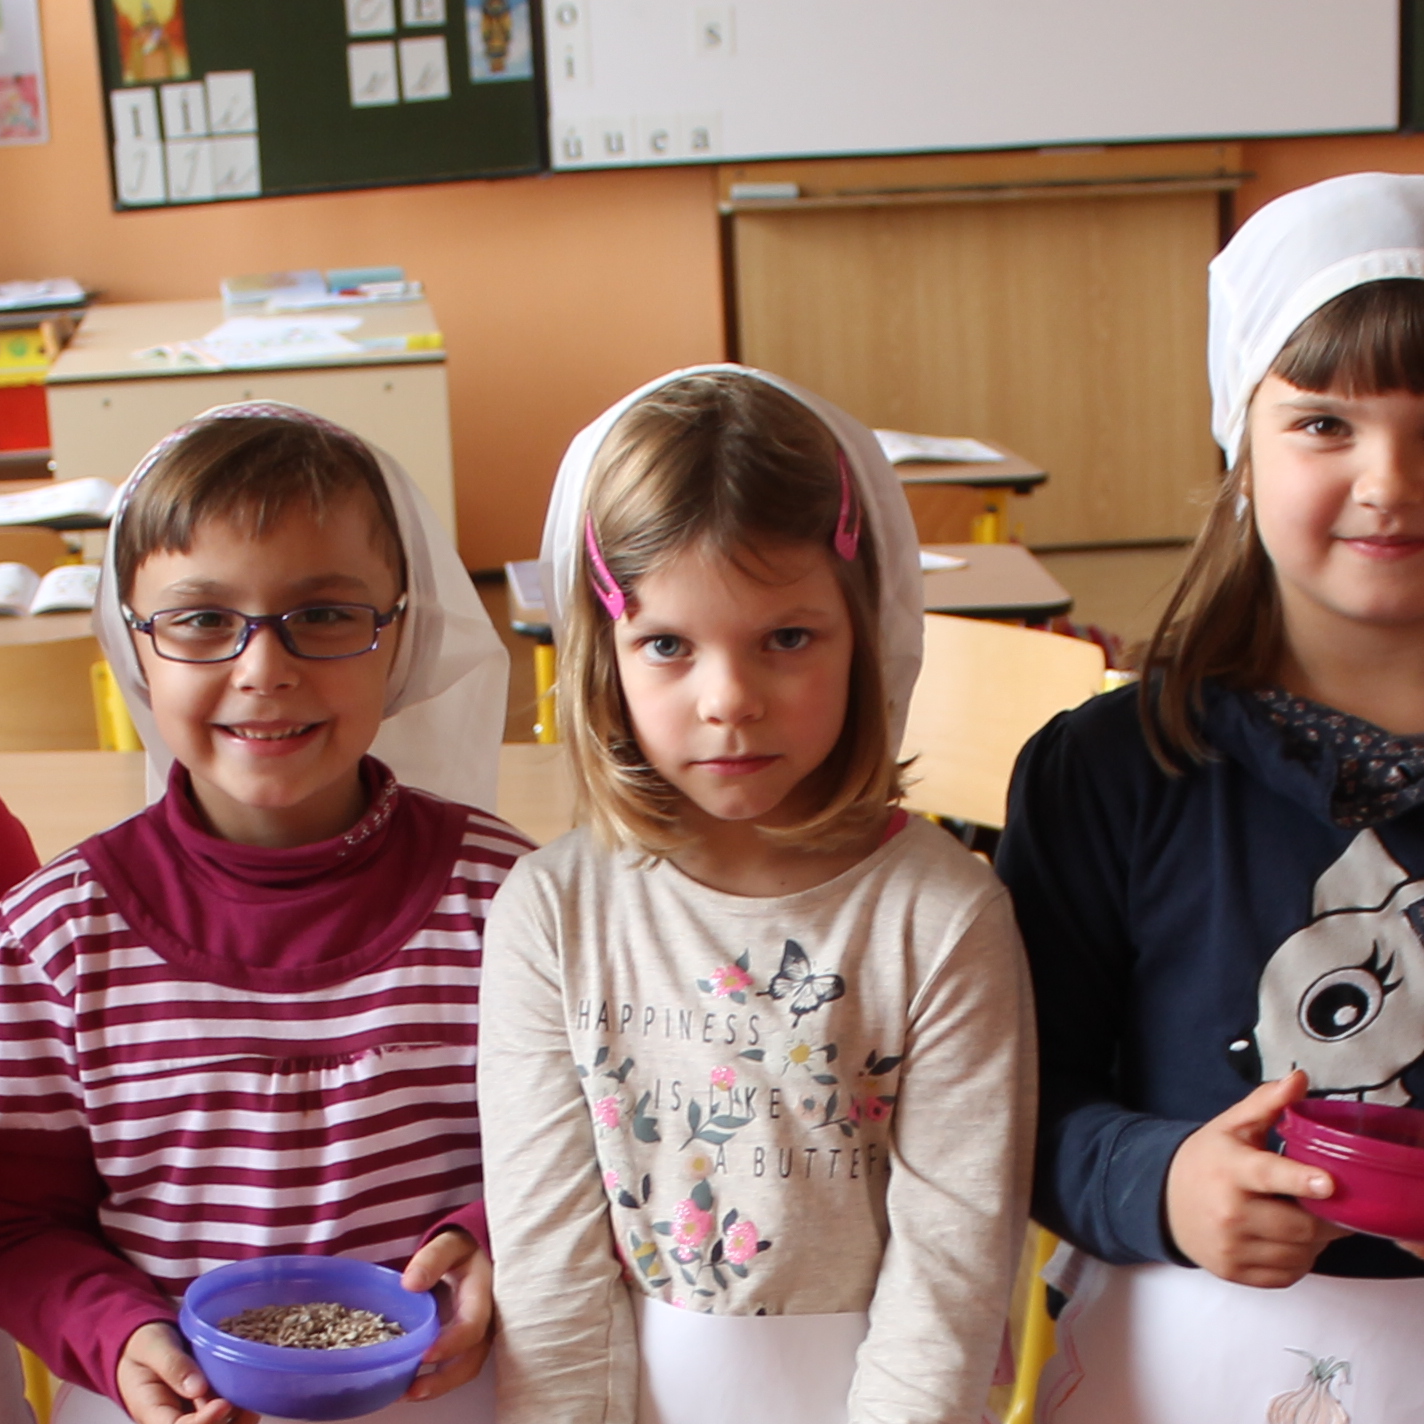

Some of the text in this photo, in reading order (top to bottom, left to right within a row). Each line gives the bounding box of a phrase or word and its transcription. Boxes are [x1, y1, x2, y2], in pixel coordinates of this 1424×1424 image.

[577, 1000, 761, 1046] HAPPINESS
[656, 1078, 682, 1112] IS
[714, 1145, 727, 1175] A
